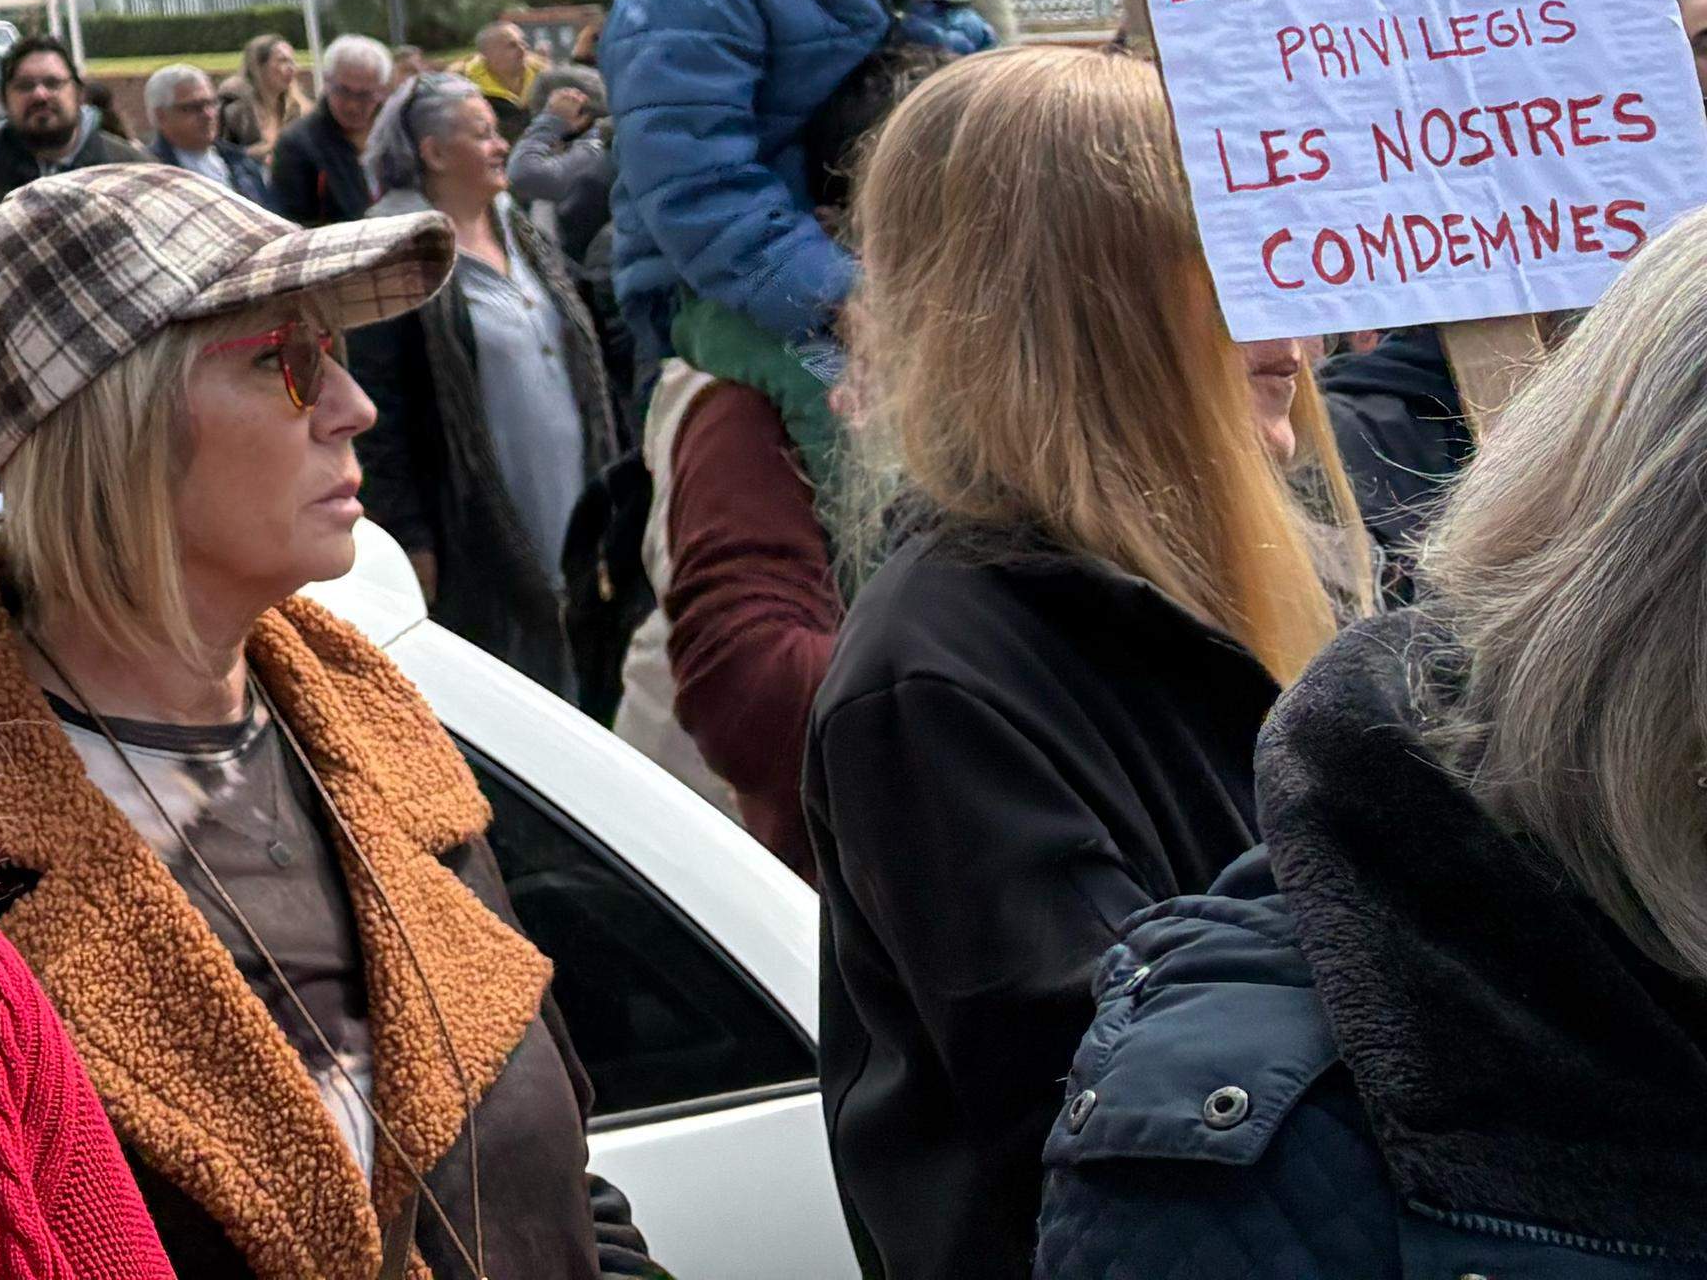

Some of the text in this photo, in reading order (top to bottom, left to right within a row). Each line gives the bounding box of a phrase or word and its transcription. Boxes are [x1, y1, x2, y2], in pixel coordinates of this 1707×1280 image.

[1276, 0, 1577, 82] PRIVILEGIS
[1215, 92, 1657, 193] LES NOSTRES
[1261, 198, 1649, 290] COMDEMNES
